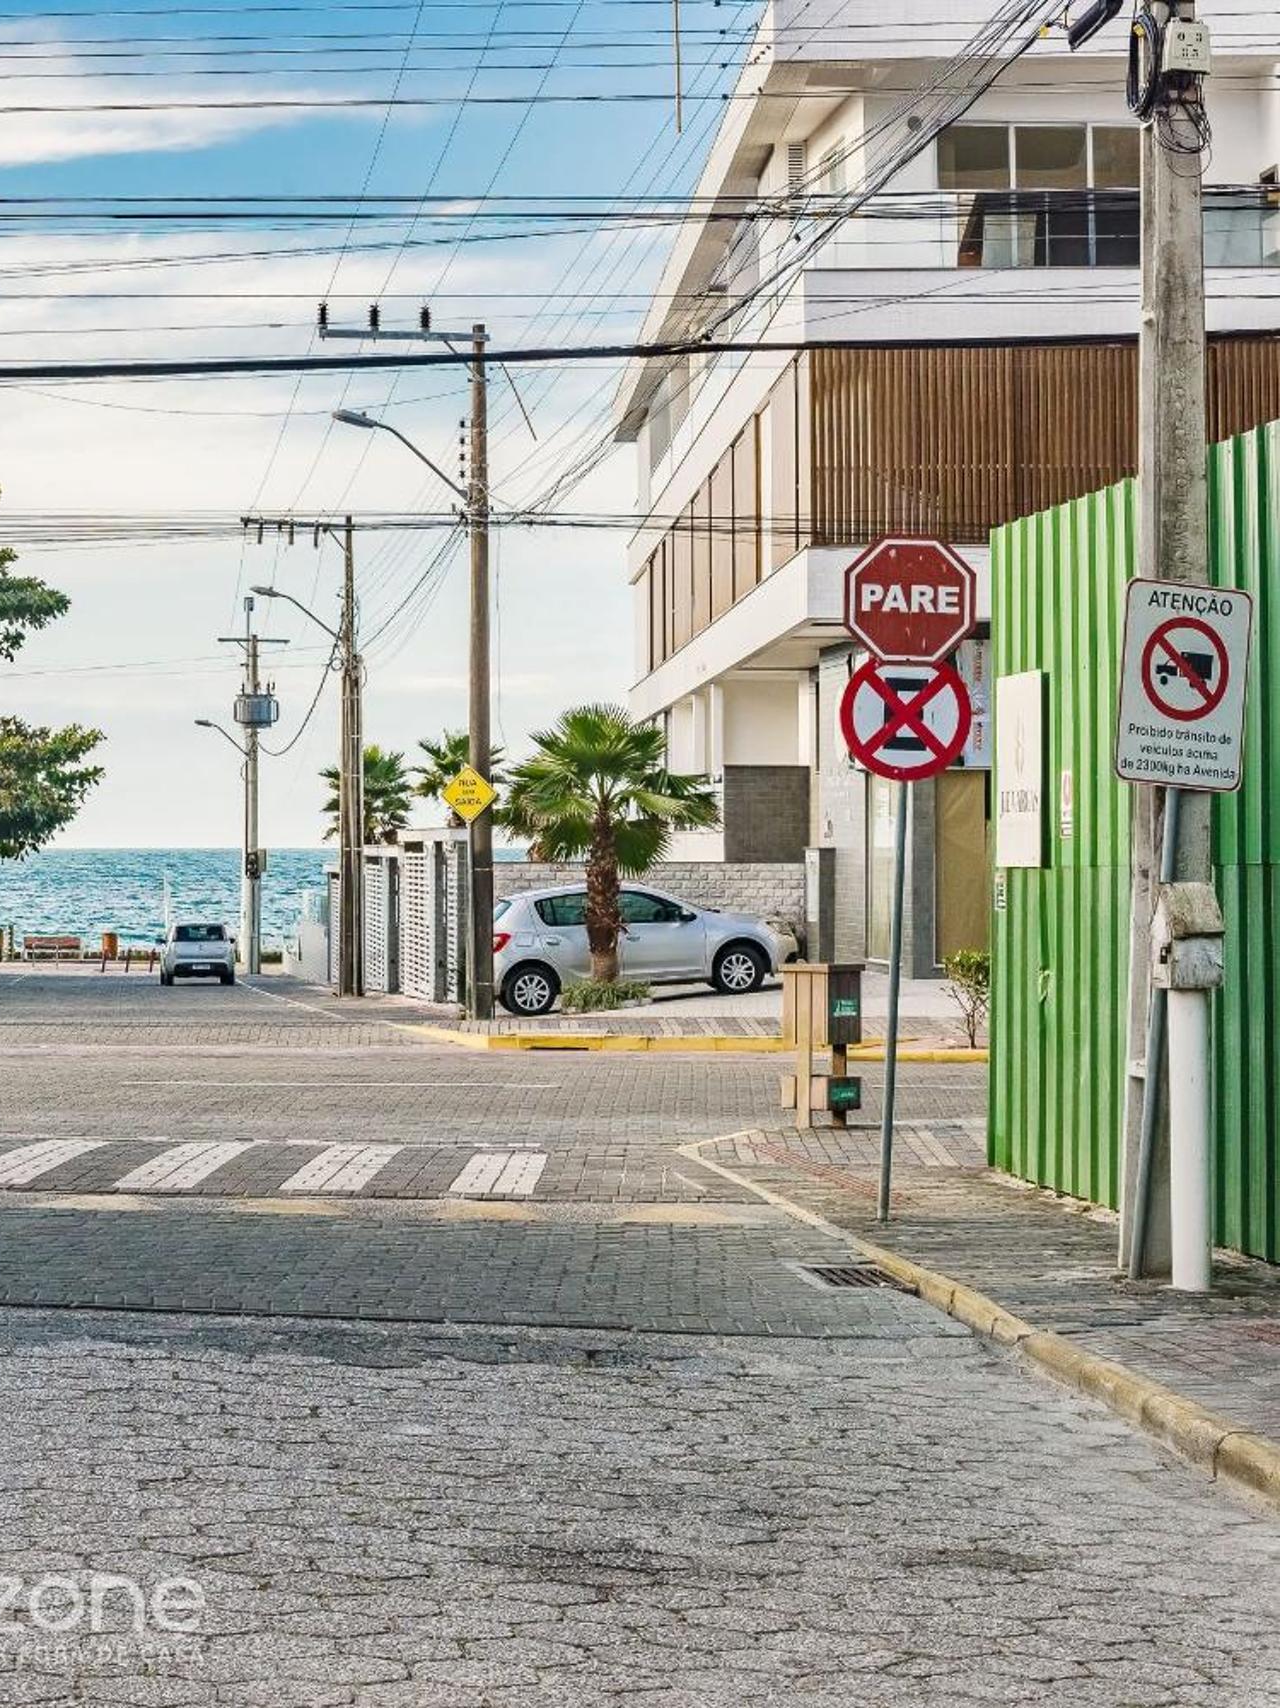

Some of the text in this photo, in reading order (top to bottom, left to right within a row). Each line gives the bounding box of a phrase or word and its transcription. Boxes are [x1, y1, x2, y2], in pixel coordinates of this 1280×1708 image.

[861, 583, 960, 614] PARE
[1148, 590, 1233, 617] ATENÇÃO
[1128, 723, 1173, 740] Proibido
[1218, 731, 1232, 745] de
[1185, 745, 1218, 760] acima
[1120, 757, 1134, 770] de
[1193, 763, 1236, 781] Avenida
